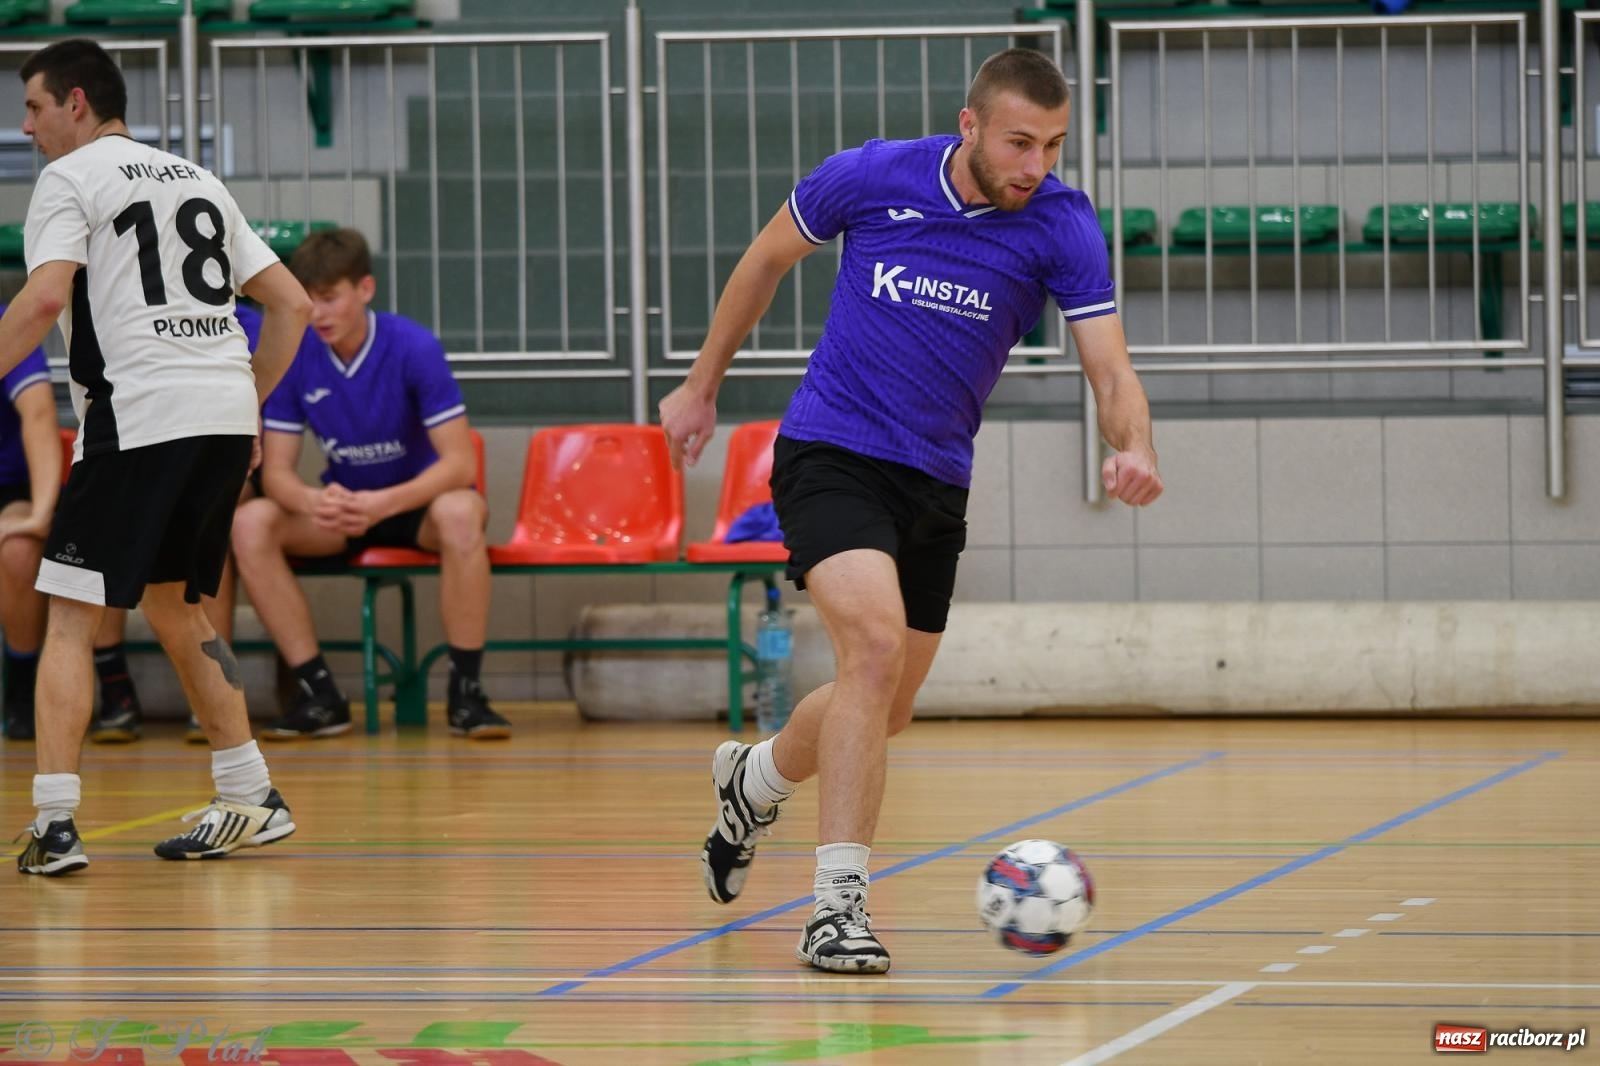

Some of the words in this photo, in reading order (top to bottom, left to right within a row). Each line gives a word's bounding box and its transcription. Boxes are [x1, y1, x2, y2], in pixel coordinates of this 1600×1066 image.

[112, 197, 233, 306] 18
[871, 262, 993, 311] K-INSTAL
[153, 316, 232, 337] PŁONIA
